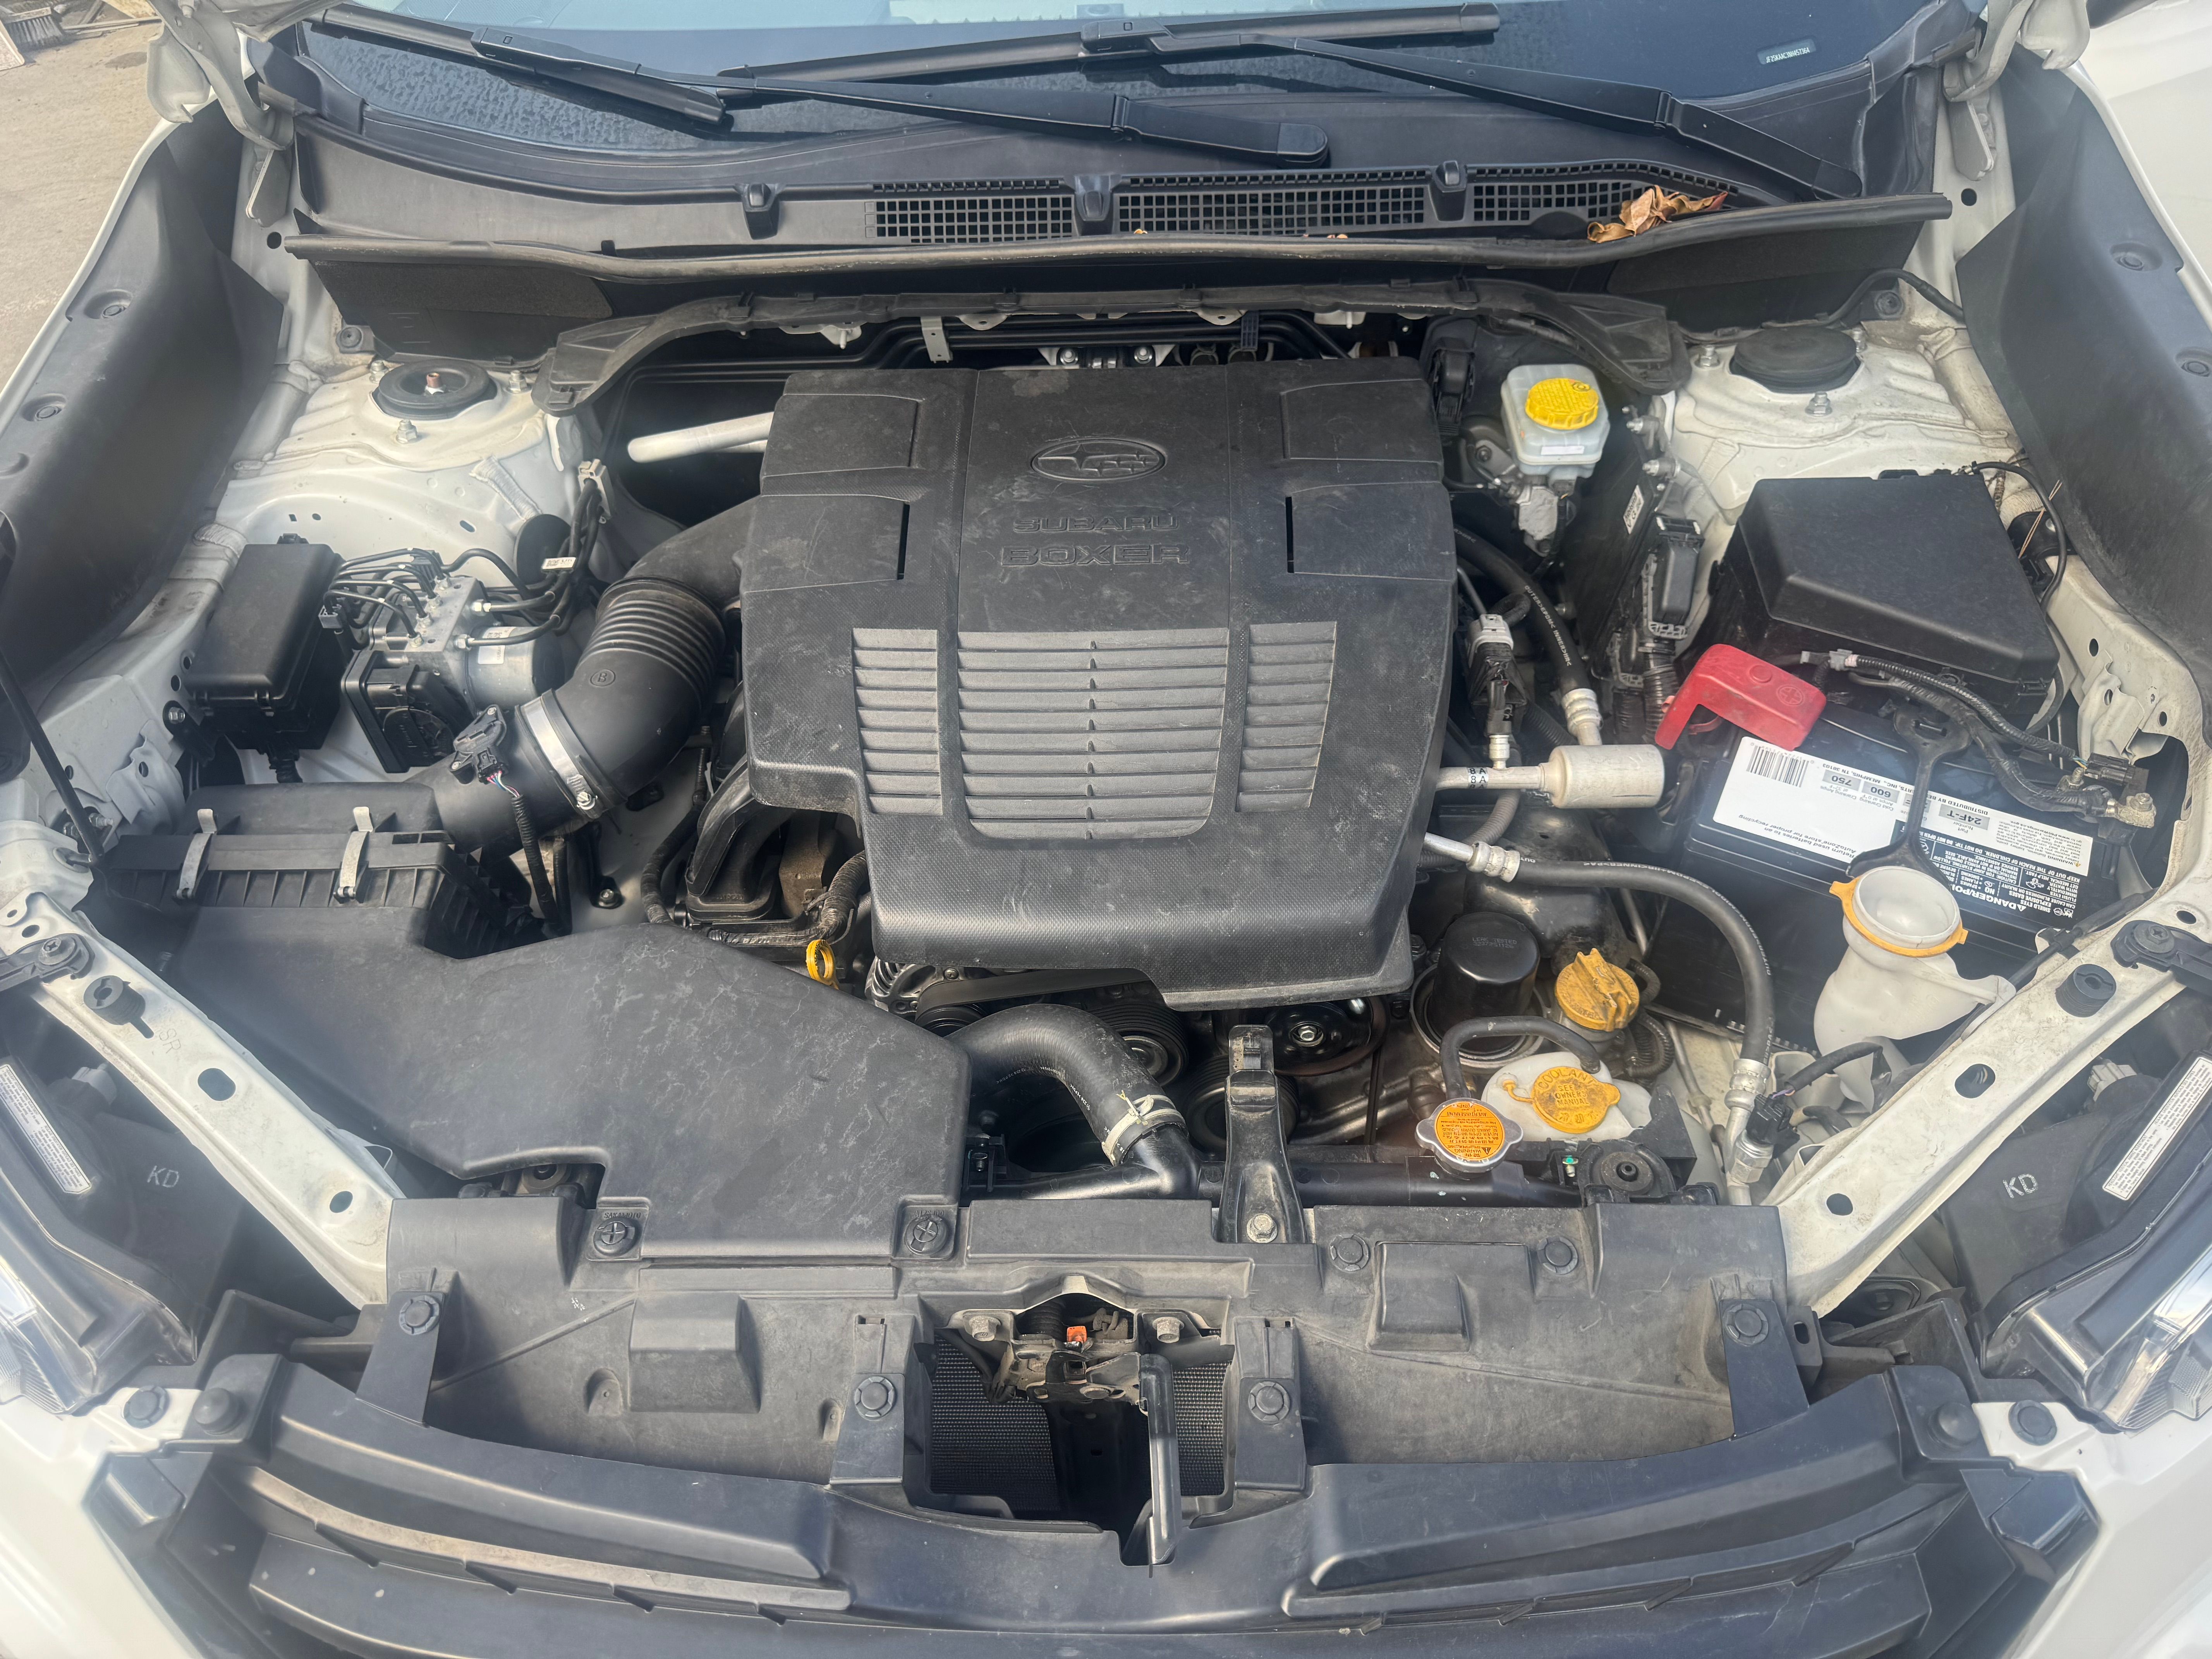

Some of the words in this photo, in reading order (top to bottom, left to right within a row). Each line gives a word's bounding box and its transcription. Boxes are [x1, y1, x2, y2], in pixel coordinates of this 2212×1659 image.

[1013, 515, 1180, 532] SUBARU
[1001, 544, 1190, 567] BOXER
[598, 673, 607, 682] B
[1822, 763, 1840, 771] 38103
[1831, 774, 1853, 787] 750
[1850, 771, 1881, 783] MEMPHIS,
[1834, 789, 1856, 800] Cranking
[1870, 786, 1891, 798] 600
[1859, 797, 1882, 807] Cranking
[1948, 800, 1988, 815] DISTRIBUTED
[1738, 814, 1768, 827] recycling
[1946, 809, 1982, 825] 24F-T
[1769, 823, 1792, 833] proper
[1953, 821, 1973, 830] Number
[1782, 833, 1812, 845] batteries
[1804, 835, 1821, 843] store
[1813, 842, 1830, 850] used
[1831, 848, 1854, 858] Return
[1984, 850, 2011, 862] CHILDREN.
[1933, 855, 1951, 864] FOLLOW
[1963, 860, 1981, 869] VEHICLE
[1973, 854, 2000, 866] ASSISTANCE.
[2047, 855, 2073, 865] WARNING
[1939, 864, 1956, 872] SEVERE
[2000, 862, 2019, 871] SERVICE
[2018, 860, 2036, 870] REACH
[1960, 870, 1979, 879] SMOKING
[1986, 867, 2017, 880] INSTRUCTIONS
[1999, 867, 2018, 876] MANUAL
[1960, 875, 1978, 884] FLAMES
[1996, 874, 2016, 884] CAUTION:
[2049, 877, 2069, 887] MEDICAL
[1960, 880, 1978, 889] SPARKS
[2001, 883, 2018, 891] INJURY
[2047, 881, 2065, 890] WATER.
[1984, 886, 1995, 895] NO
[2008, 890, 2025, 899] GASES
[2025, 890, 2050, 901] BLINDNESS
[2047, 885, 2077, 898] IMMEDIATELY
[1949, 883, 2017, 910] DANGER/POI
[2025, 895, 2051, 907] EXPLOSIVE
[2061, 894, 2076, 902] FLUSH
[2050, 898, 2066, 906] CAUSE
[2033, 903, 2051, 912] SHIELD
[1538, 1068, 1595, 1090] COOLANT
[1556, 1091, 1587, 1100] OWNERS
[1557, 1097, 1590, 1106] MANUAL
[147, 1165, 179, 1188] KD
[2003, 1173, 2038, 1198] KD
